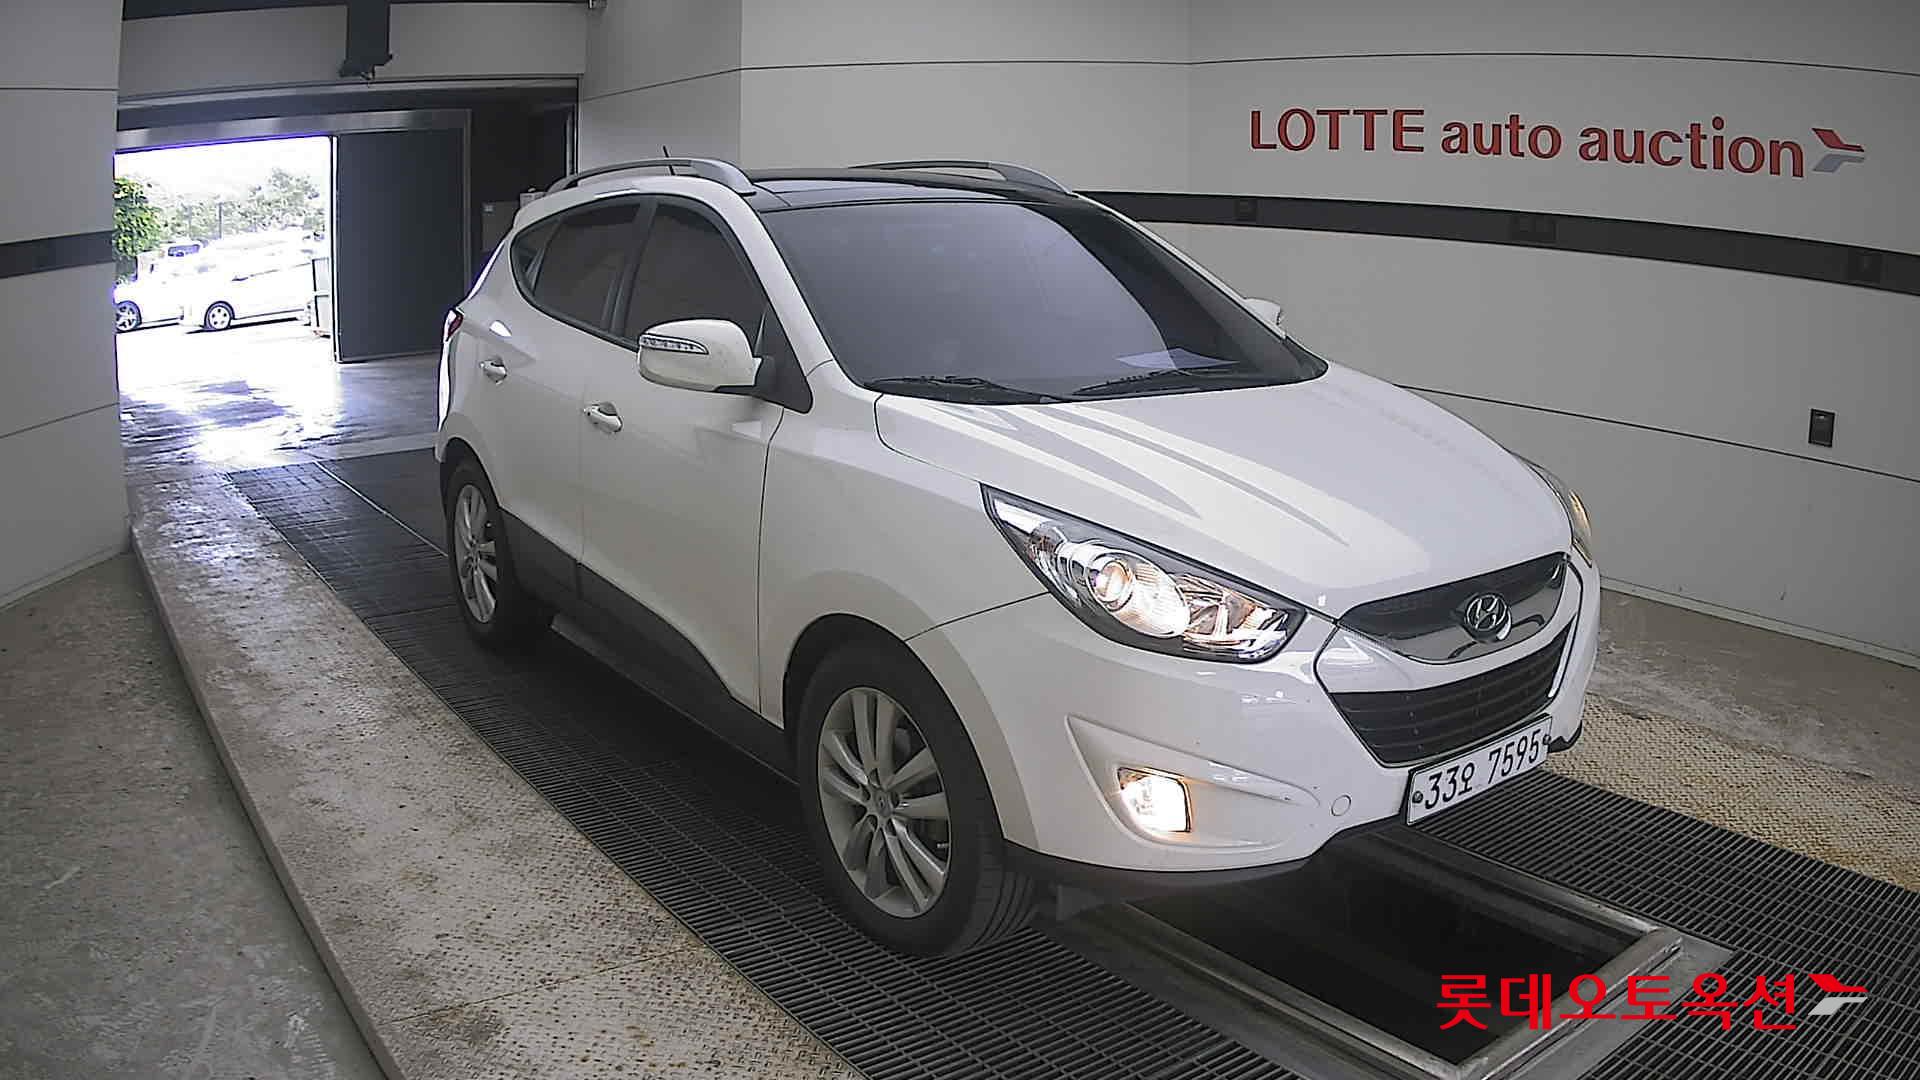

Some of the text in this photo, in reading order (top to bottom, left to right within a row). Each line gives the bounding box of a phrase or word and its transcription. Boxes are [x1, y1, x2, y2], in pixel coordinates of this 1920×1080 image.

[1250, 108, 1805, 179] LOTTE auto auction
[1424, 728, 1542, 811] 33오 7595
